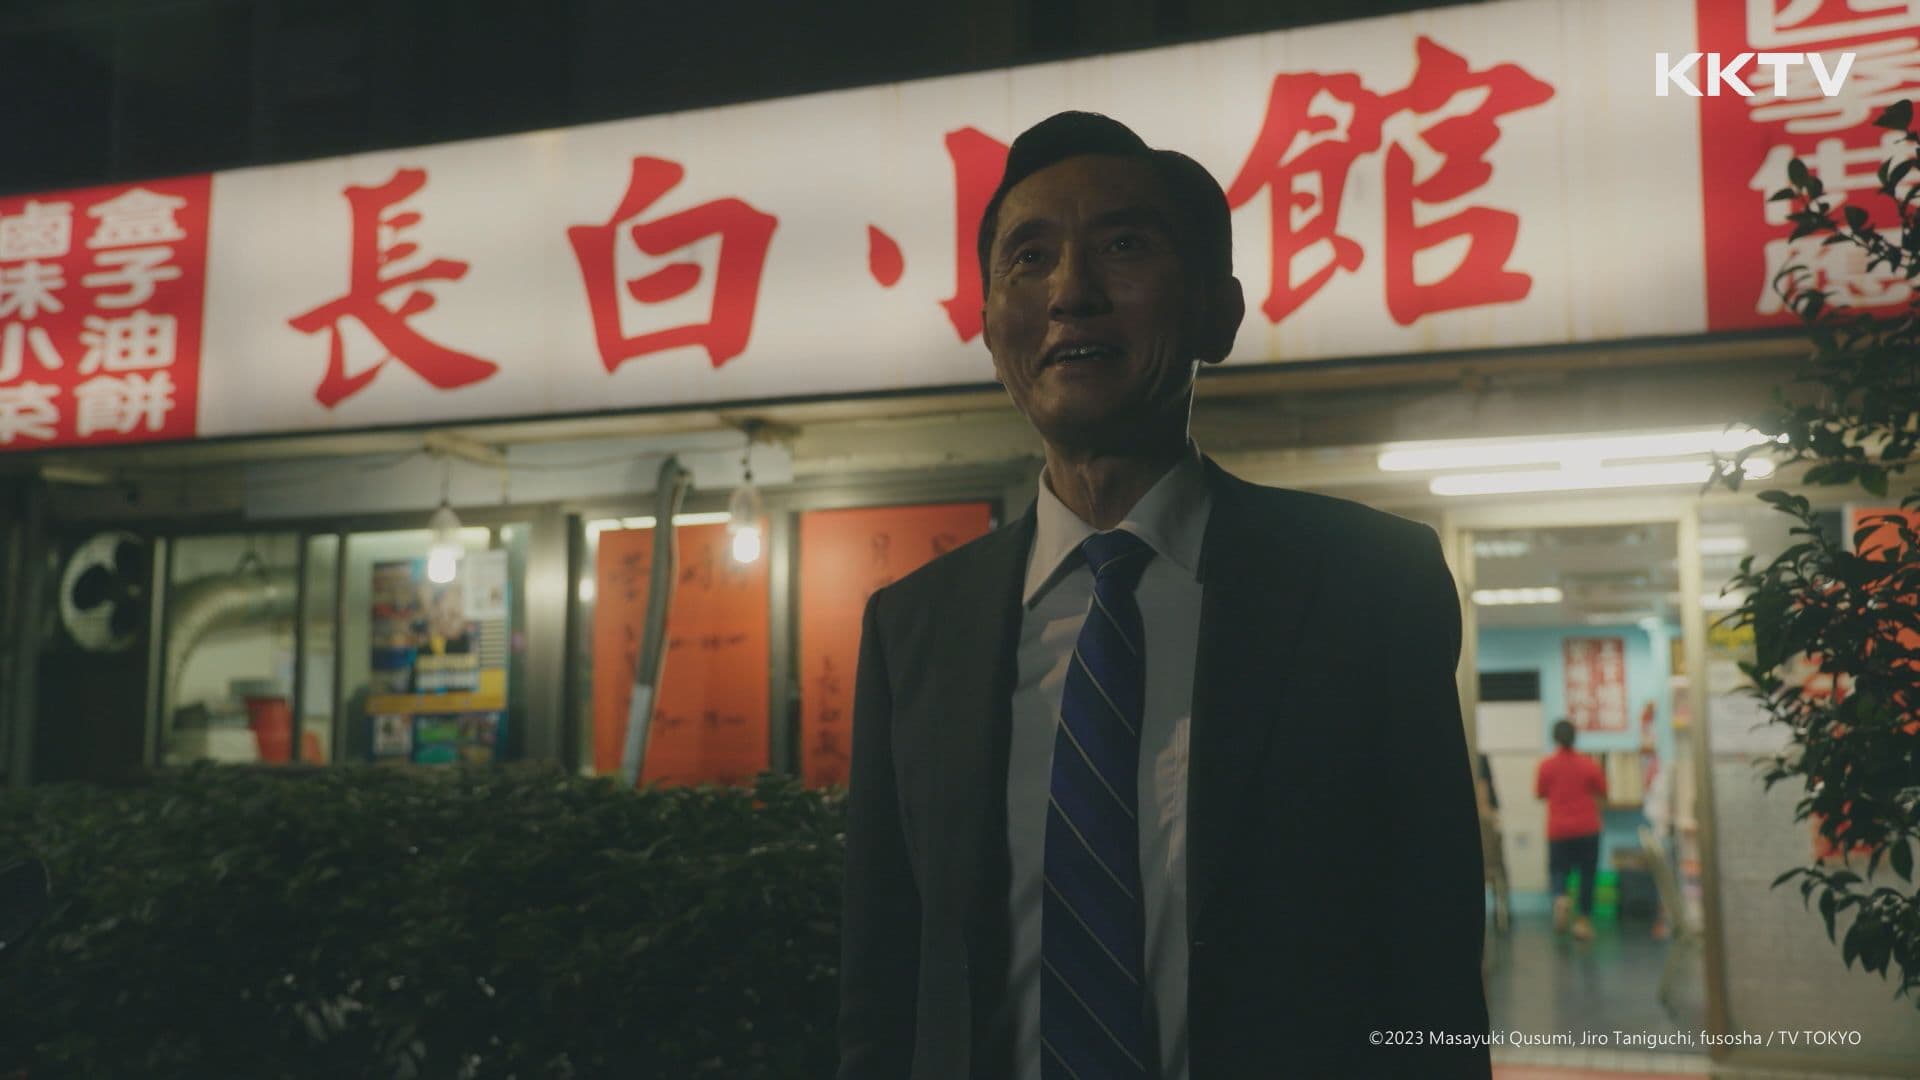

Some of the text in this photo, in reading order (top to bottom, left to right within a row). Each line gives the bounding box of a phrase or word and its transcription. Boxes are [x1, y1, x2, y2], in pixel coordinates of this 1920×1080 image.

[74, 187, 187, 436] 盒子油餅
[288, 36, 1556, 406] 長白小館
